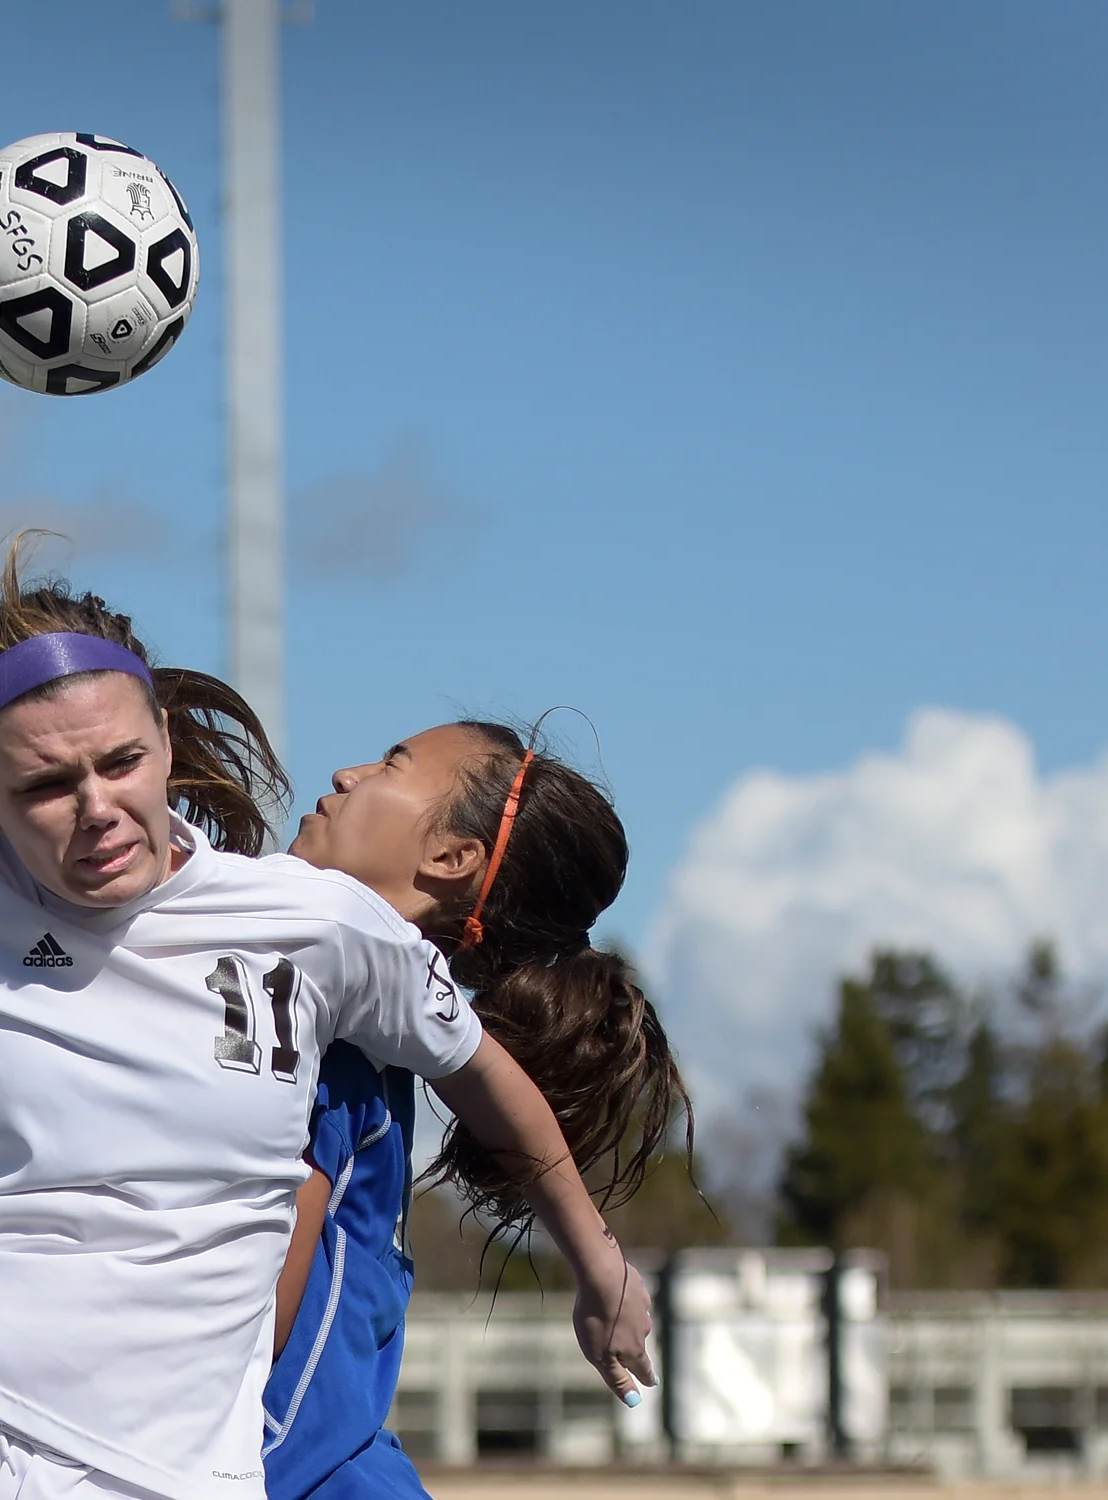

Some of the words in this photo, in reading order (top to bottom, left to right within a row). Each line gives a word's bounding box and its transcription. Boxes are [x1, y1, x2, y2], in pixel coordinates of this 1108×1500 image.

[112, 170, 154, 183] BRINE
[23, 952, 74, 968] adidas
[205, 955, 303, 1085] 11
